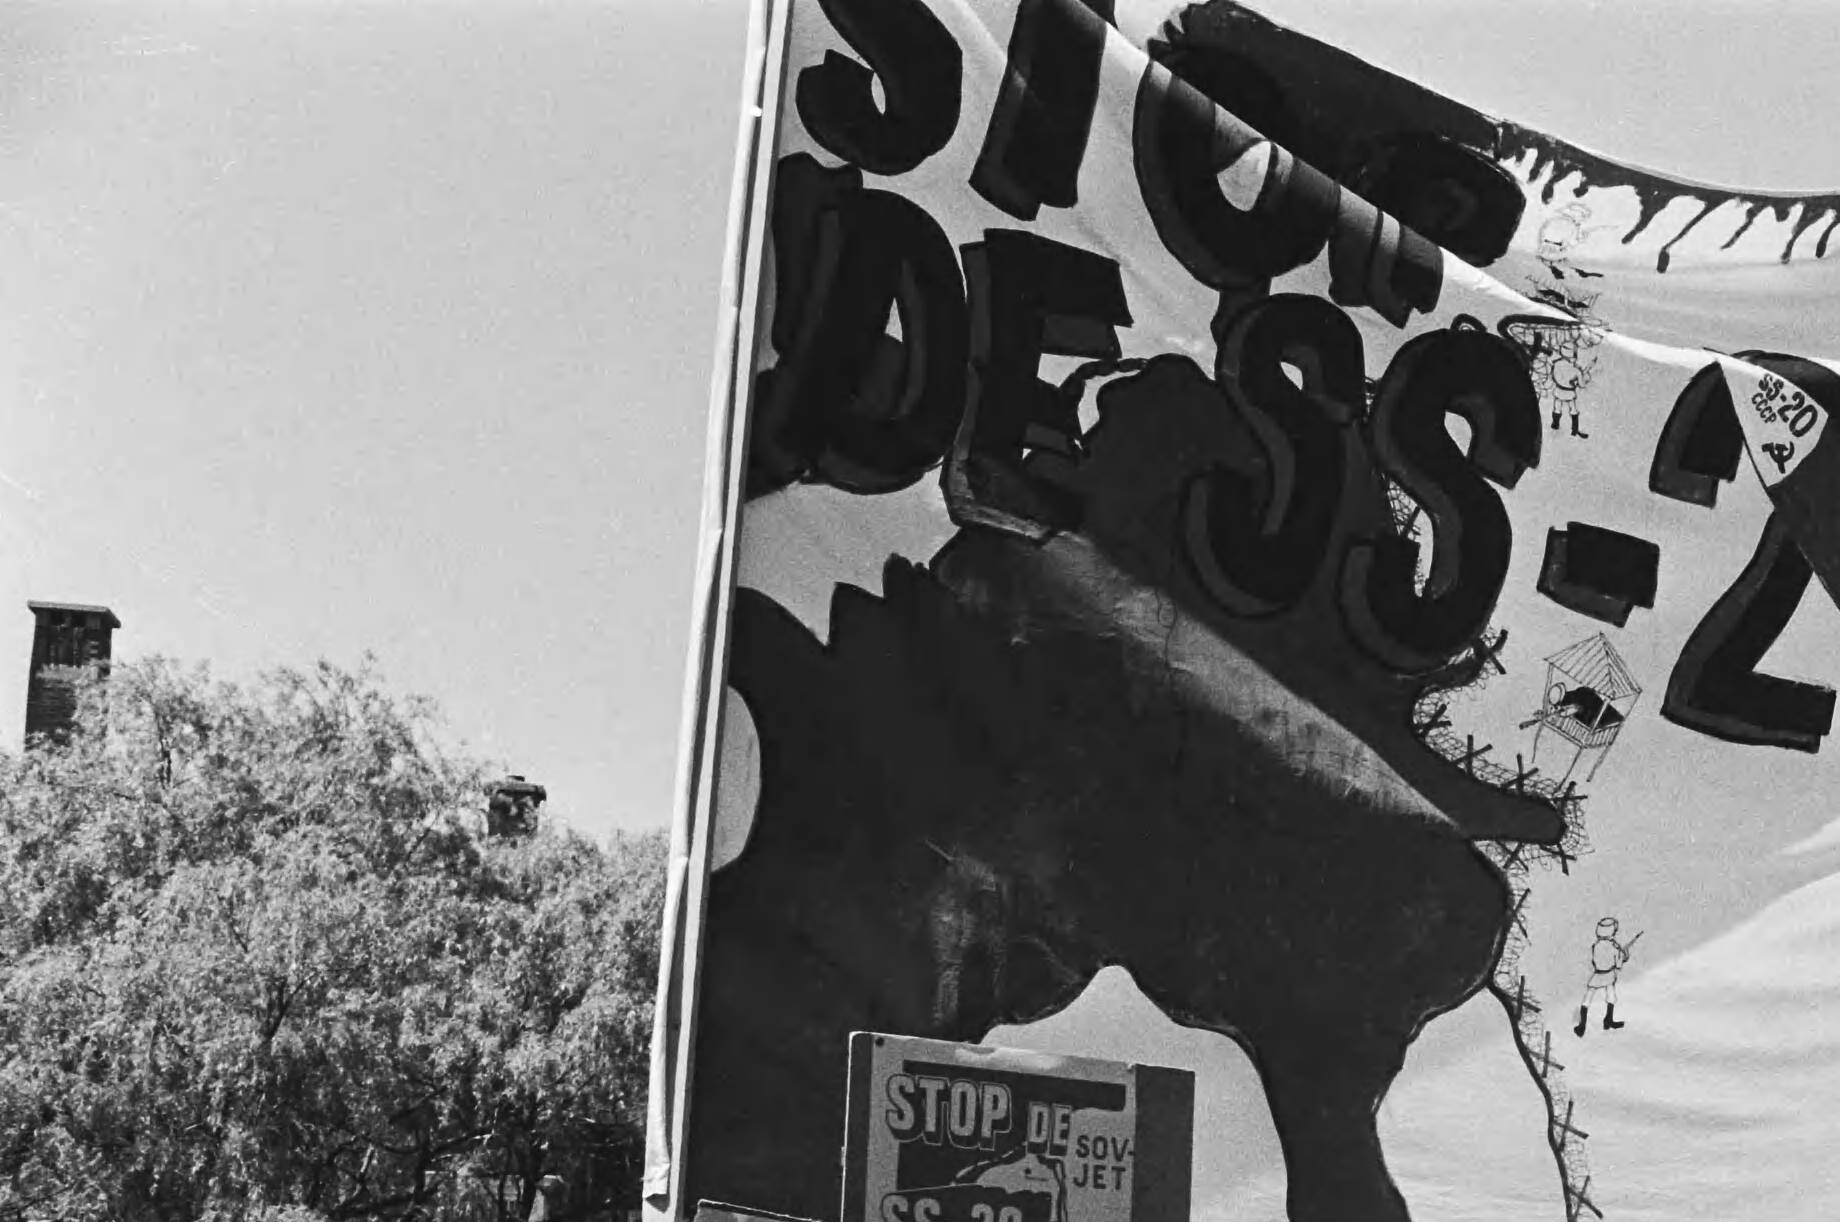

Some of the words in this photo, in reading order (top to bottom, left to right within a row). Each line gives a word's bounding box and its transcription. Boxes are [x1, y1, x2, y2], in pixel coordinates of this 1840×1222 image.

[742, 151, 1133, 548] DE
[1758, 373, 1818, 438] SS-20
[885, 1073, 1012, 1151] STOP
[1027, 1102, 1072, 1157] DE
[1073, 1164, 1127, 1191] JET
